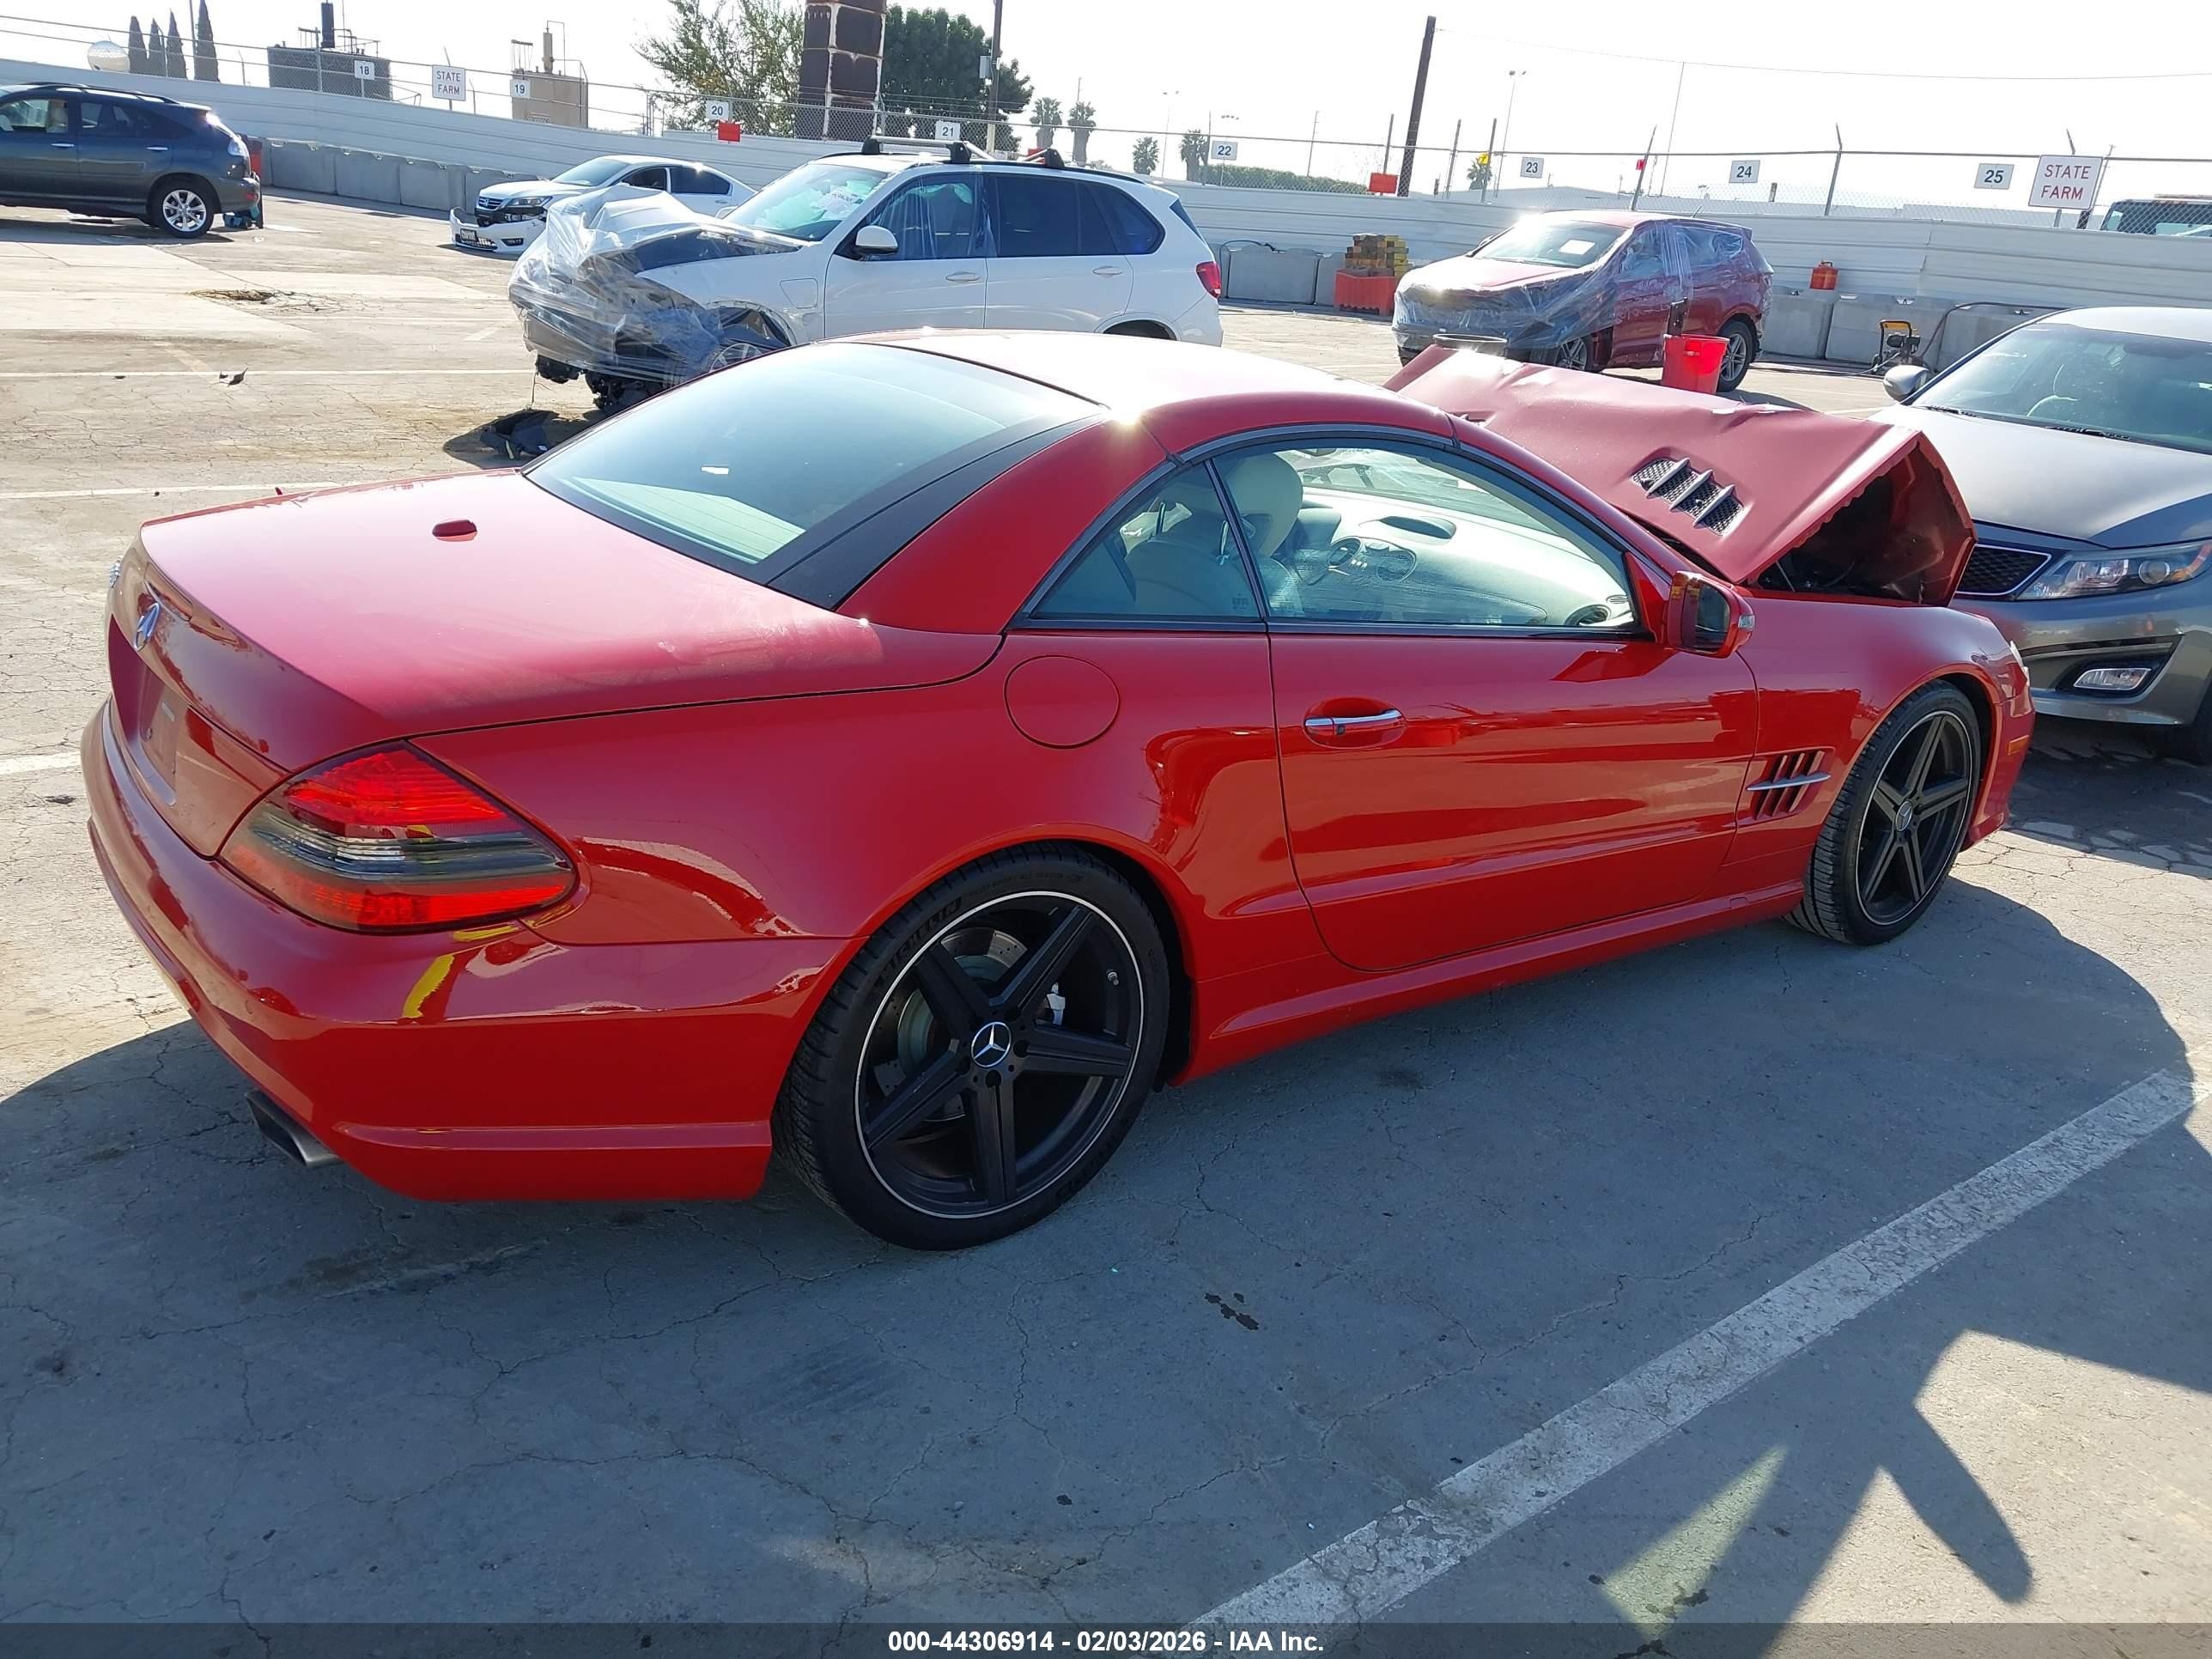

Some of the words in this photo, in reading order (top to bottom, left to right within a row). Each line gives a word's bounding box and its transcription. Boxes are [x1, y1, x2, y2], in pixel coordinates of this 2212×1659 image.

[360, 65, 369, 76] 18
[436, 70, 461, 82] STATE
[438, 83, 460, 95] FARM
[514, 83, 526, 94] 19
[711, 105, 724, 116] 20
[942, 126, 954, 137] 21
[1217, 145, 1231, 155] 22
[1526, 161, 1539, 173] 23
[1736, 166, 1753, 178] 24
[2044, 164, 2092, 179] STATE
[1984, 170, 2004, 184] 25
[2040, 185, 2084, 201] FARM
